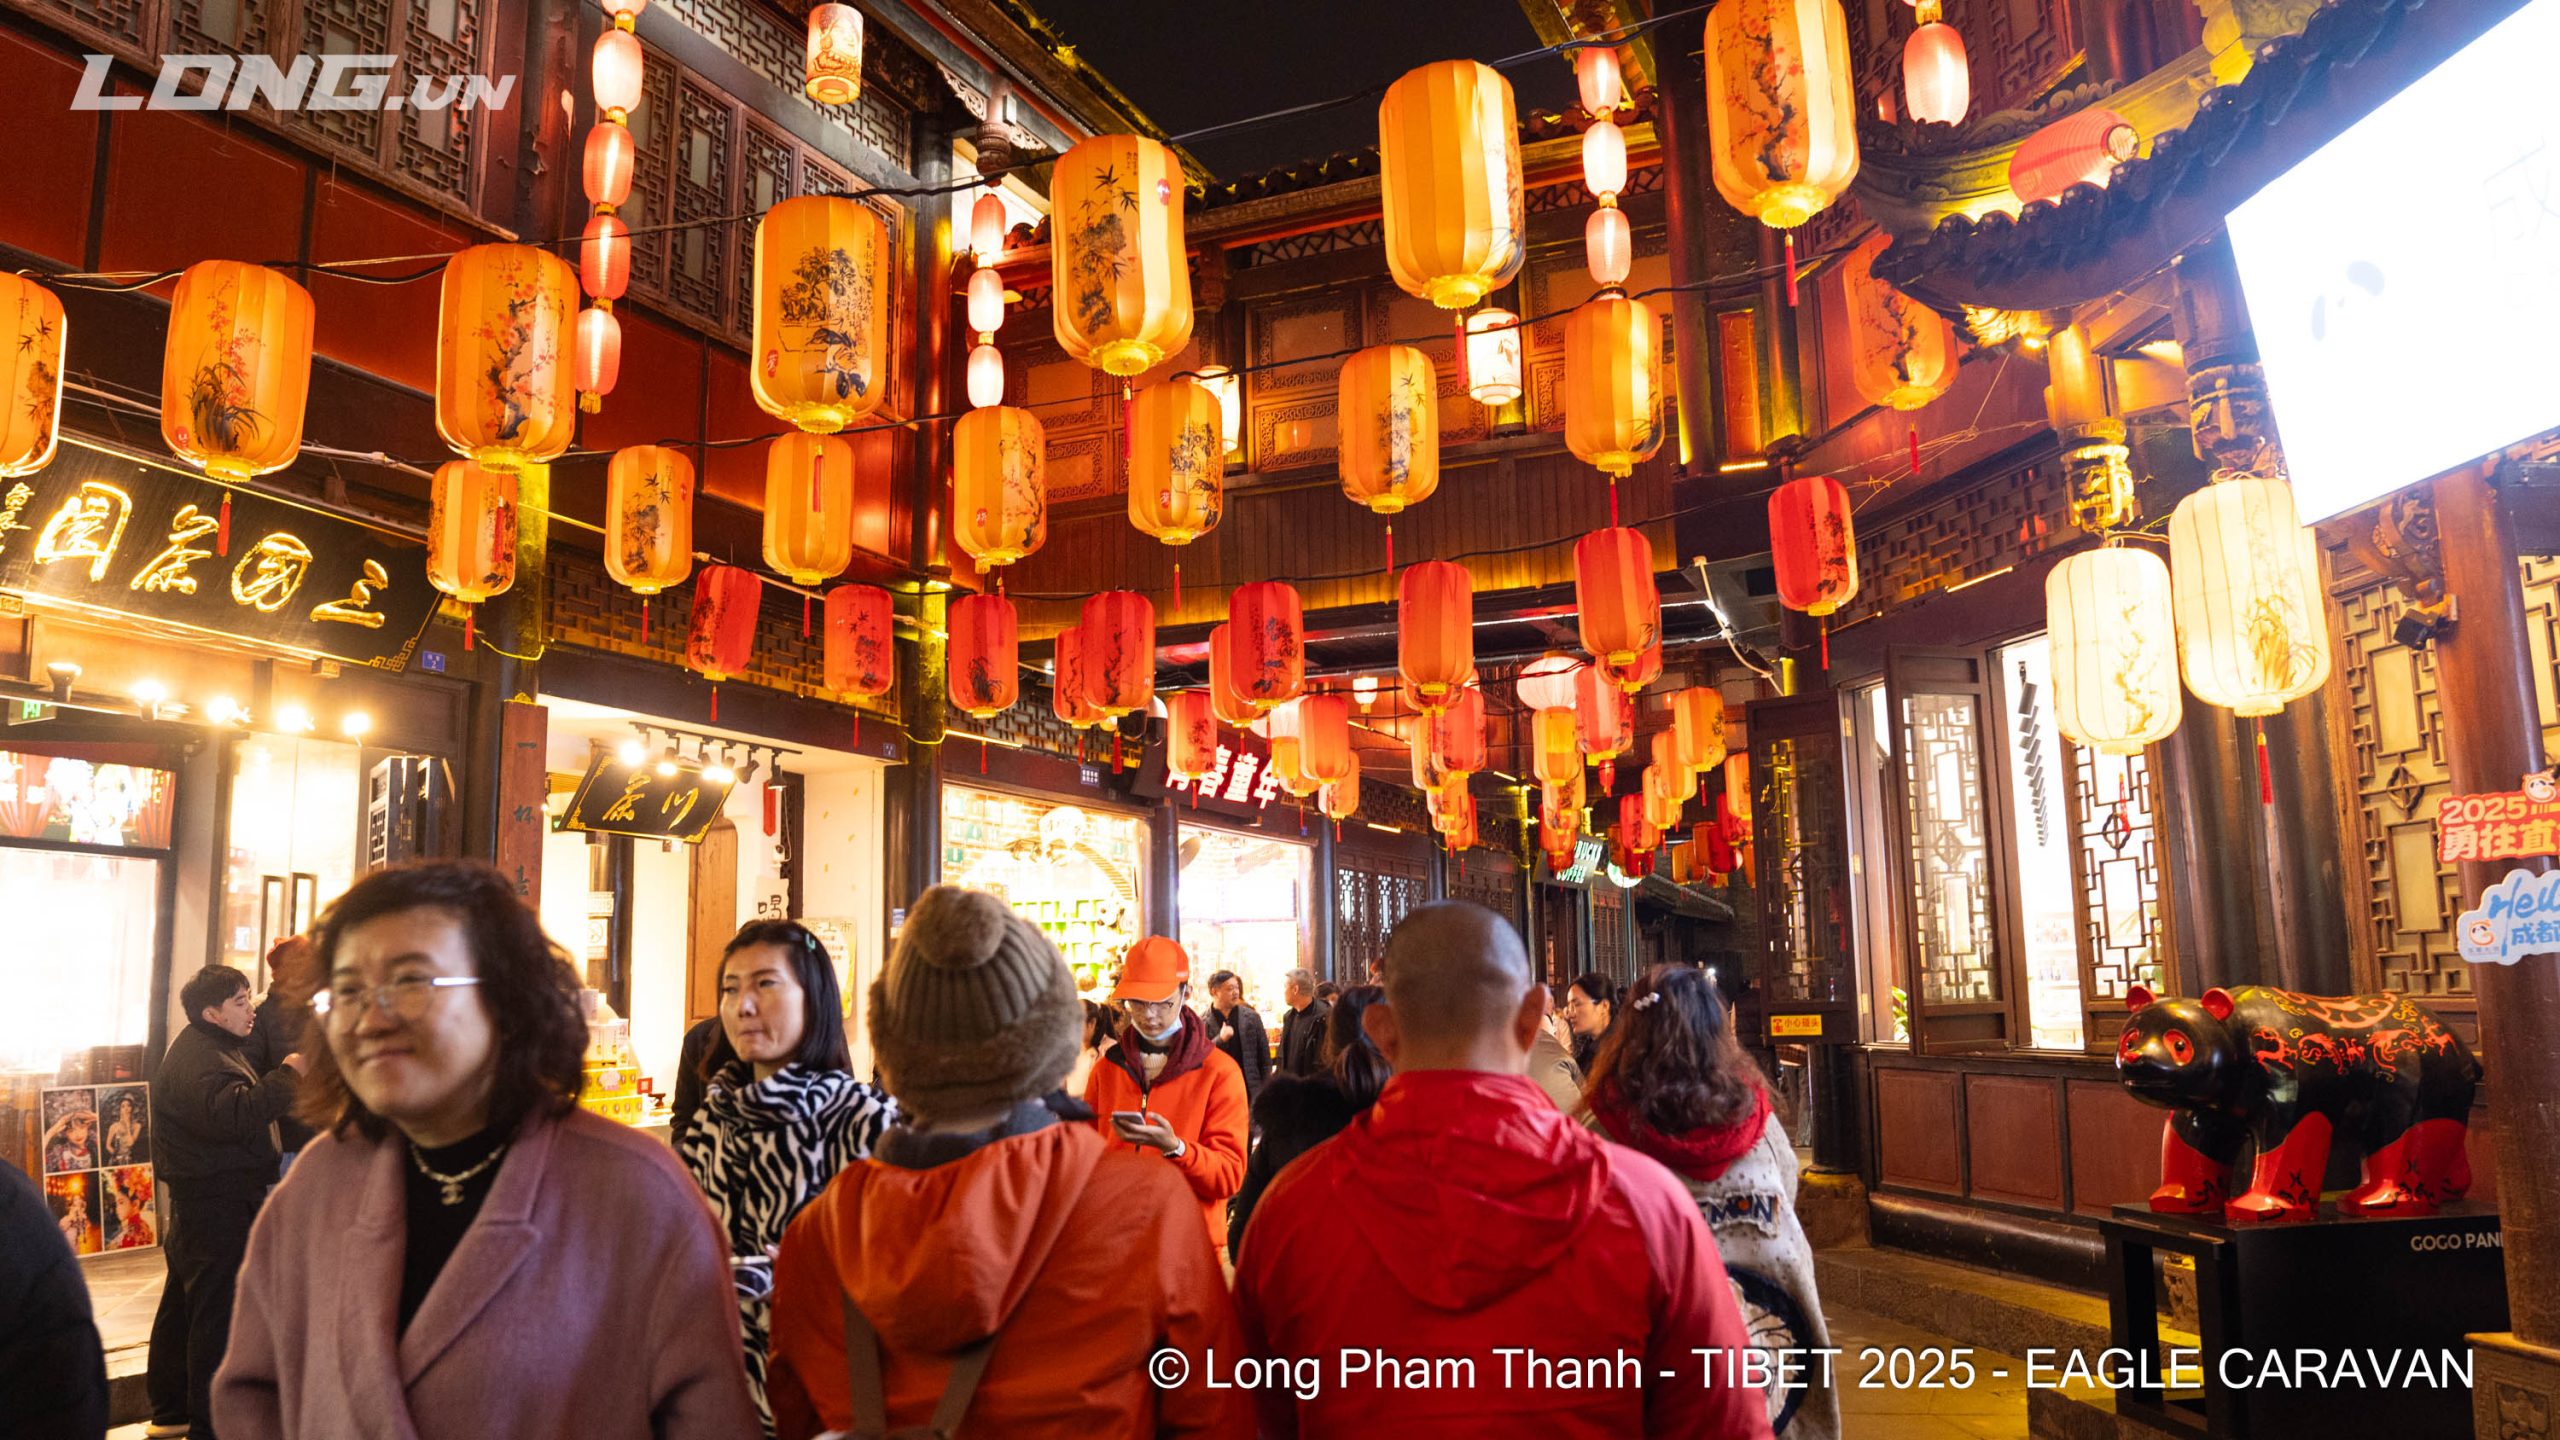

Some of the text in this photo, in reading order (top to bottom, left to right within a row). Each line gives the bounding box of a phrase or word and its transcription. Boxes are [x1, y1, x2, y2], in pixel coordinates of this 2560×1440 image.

[2443, 818, 2560, 862] 勇往直
[2410, 1233, 2462, 1252] GOGO
